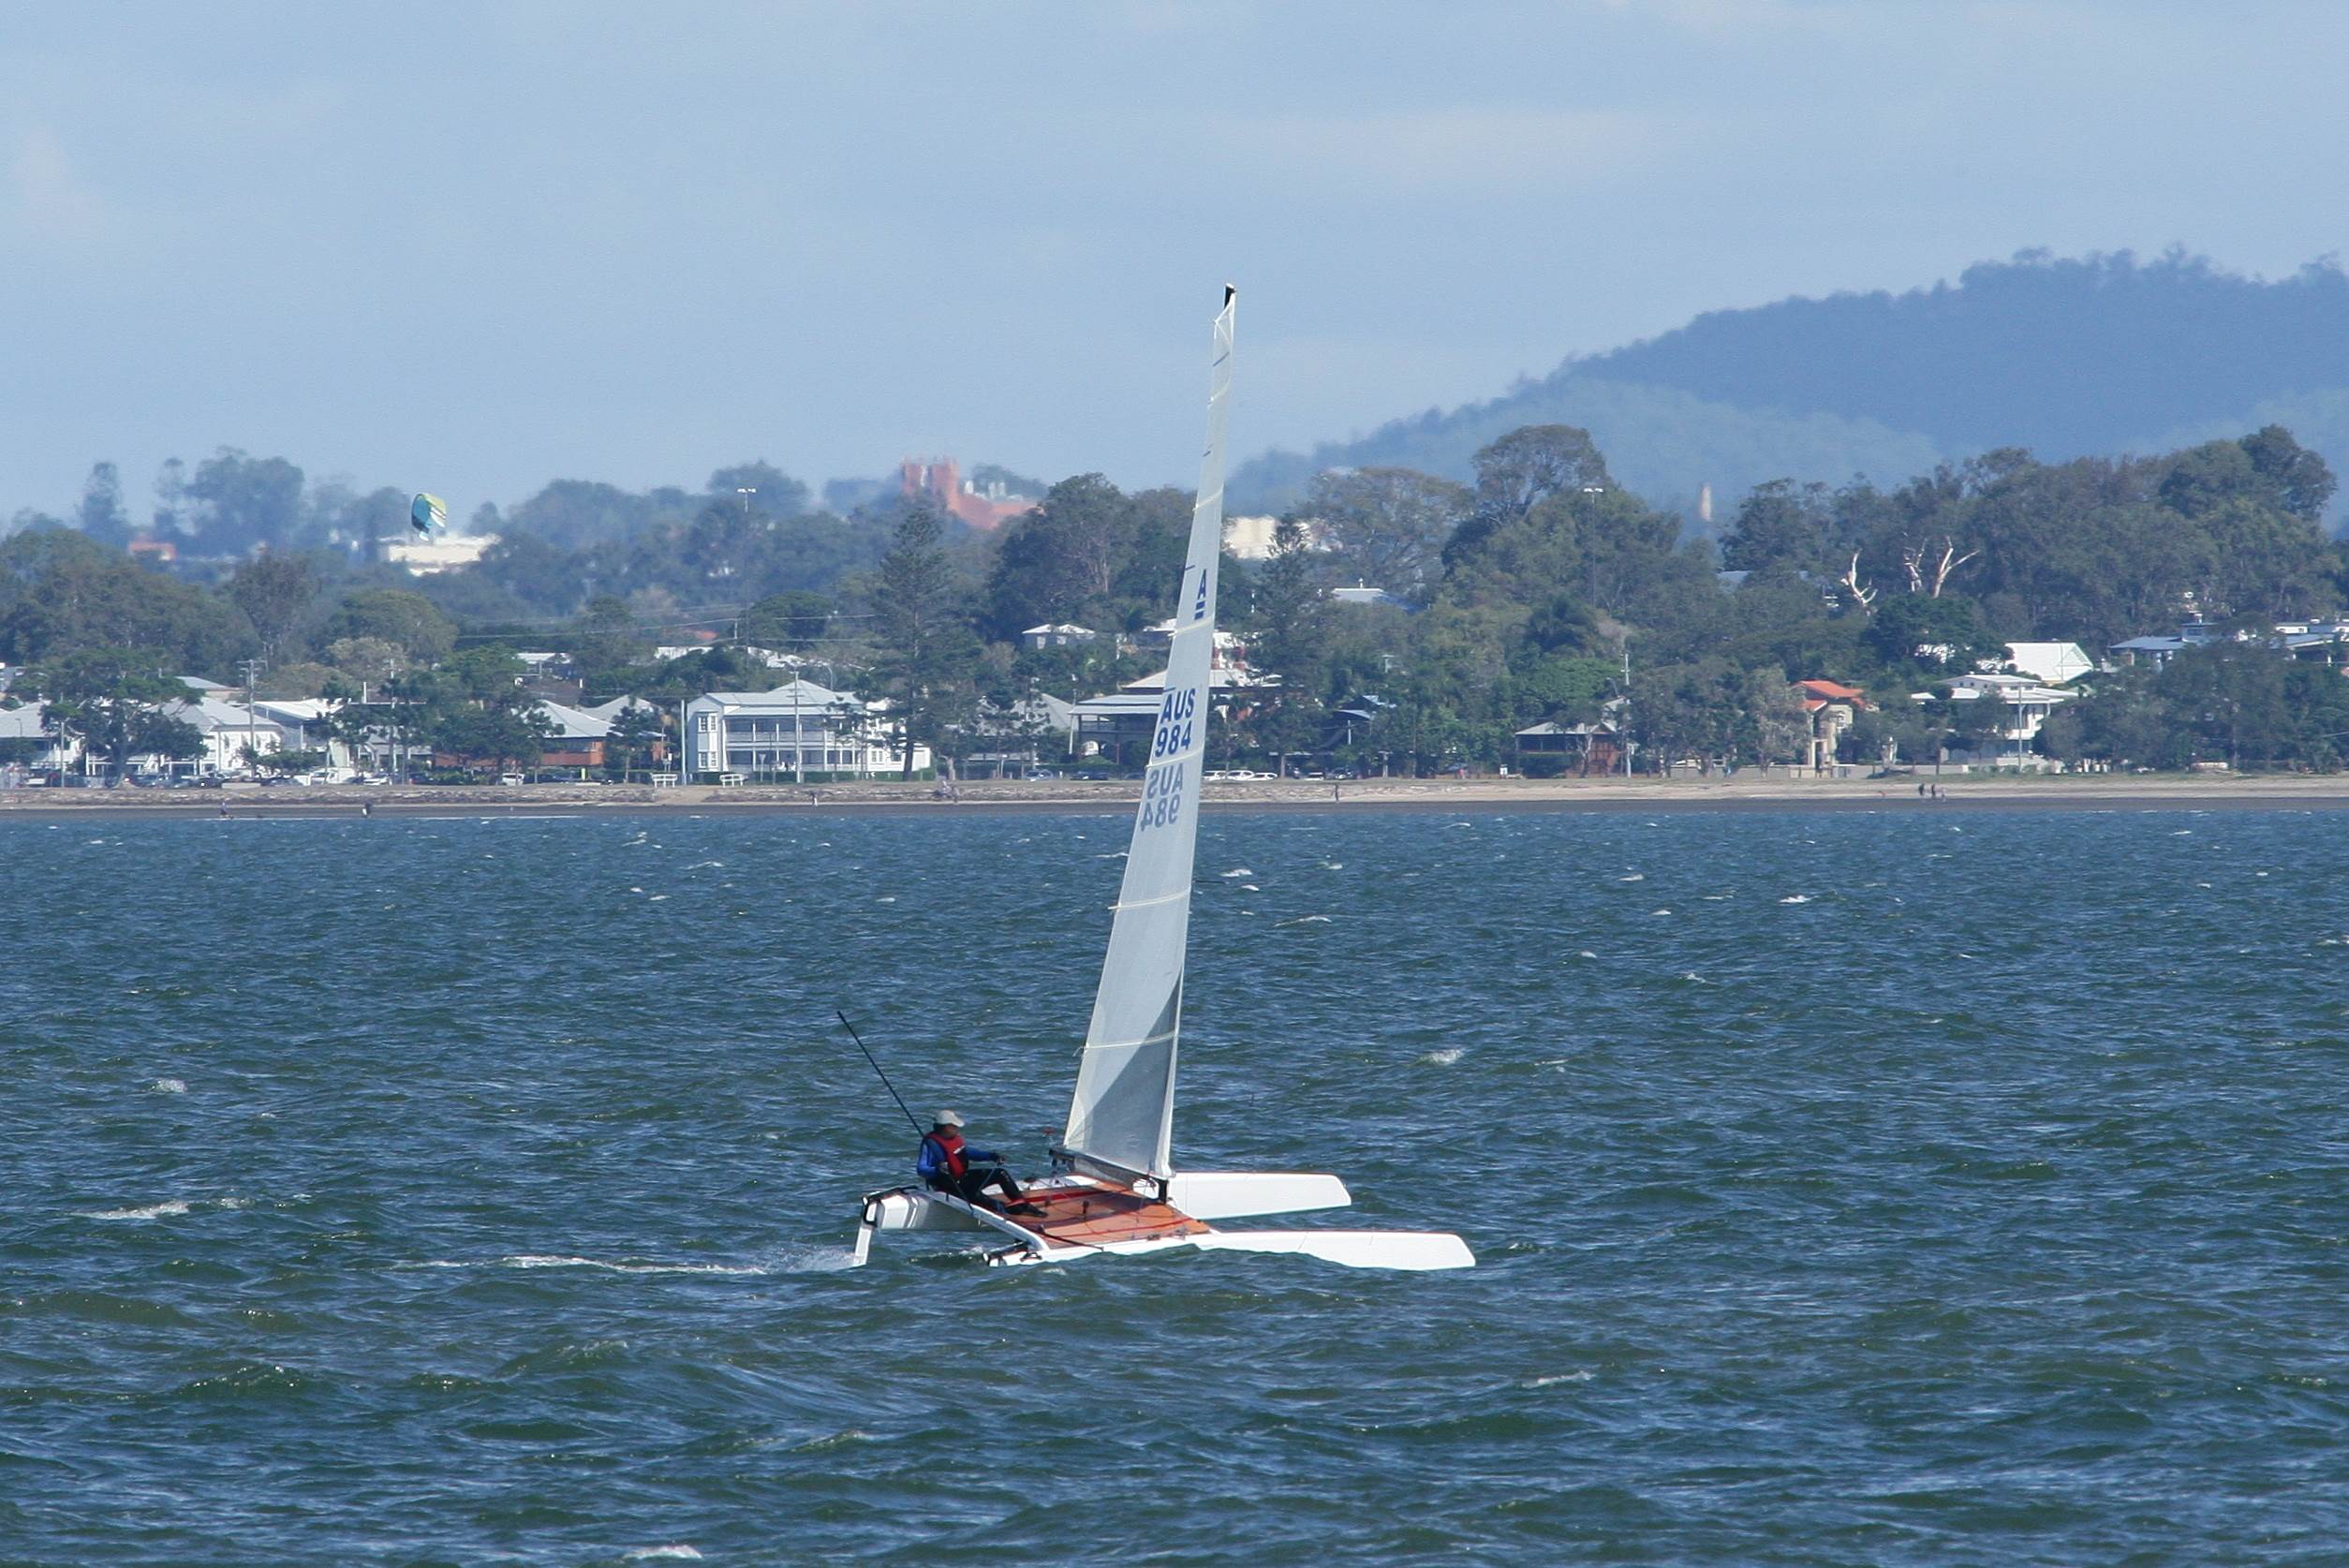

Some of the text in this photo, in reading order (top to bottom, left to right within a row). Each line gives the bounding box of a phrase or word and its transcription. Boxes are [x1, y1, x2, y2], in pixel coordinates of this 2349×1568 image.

[1197, 569, 1206, 599] A
[1160, 688, 1195, 724] AUS
[1155, 720, 1191, 757] 984
